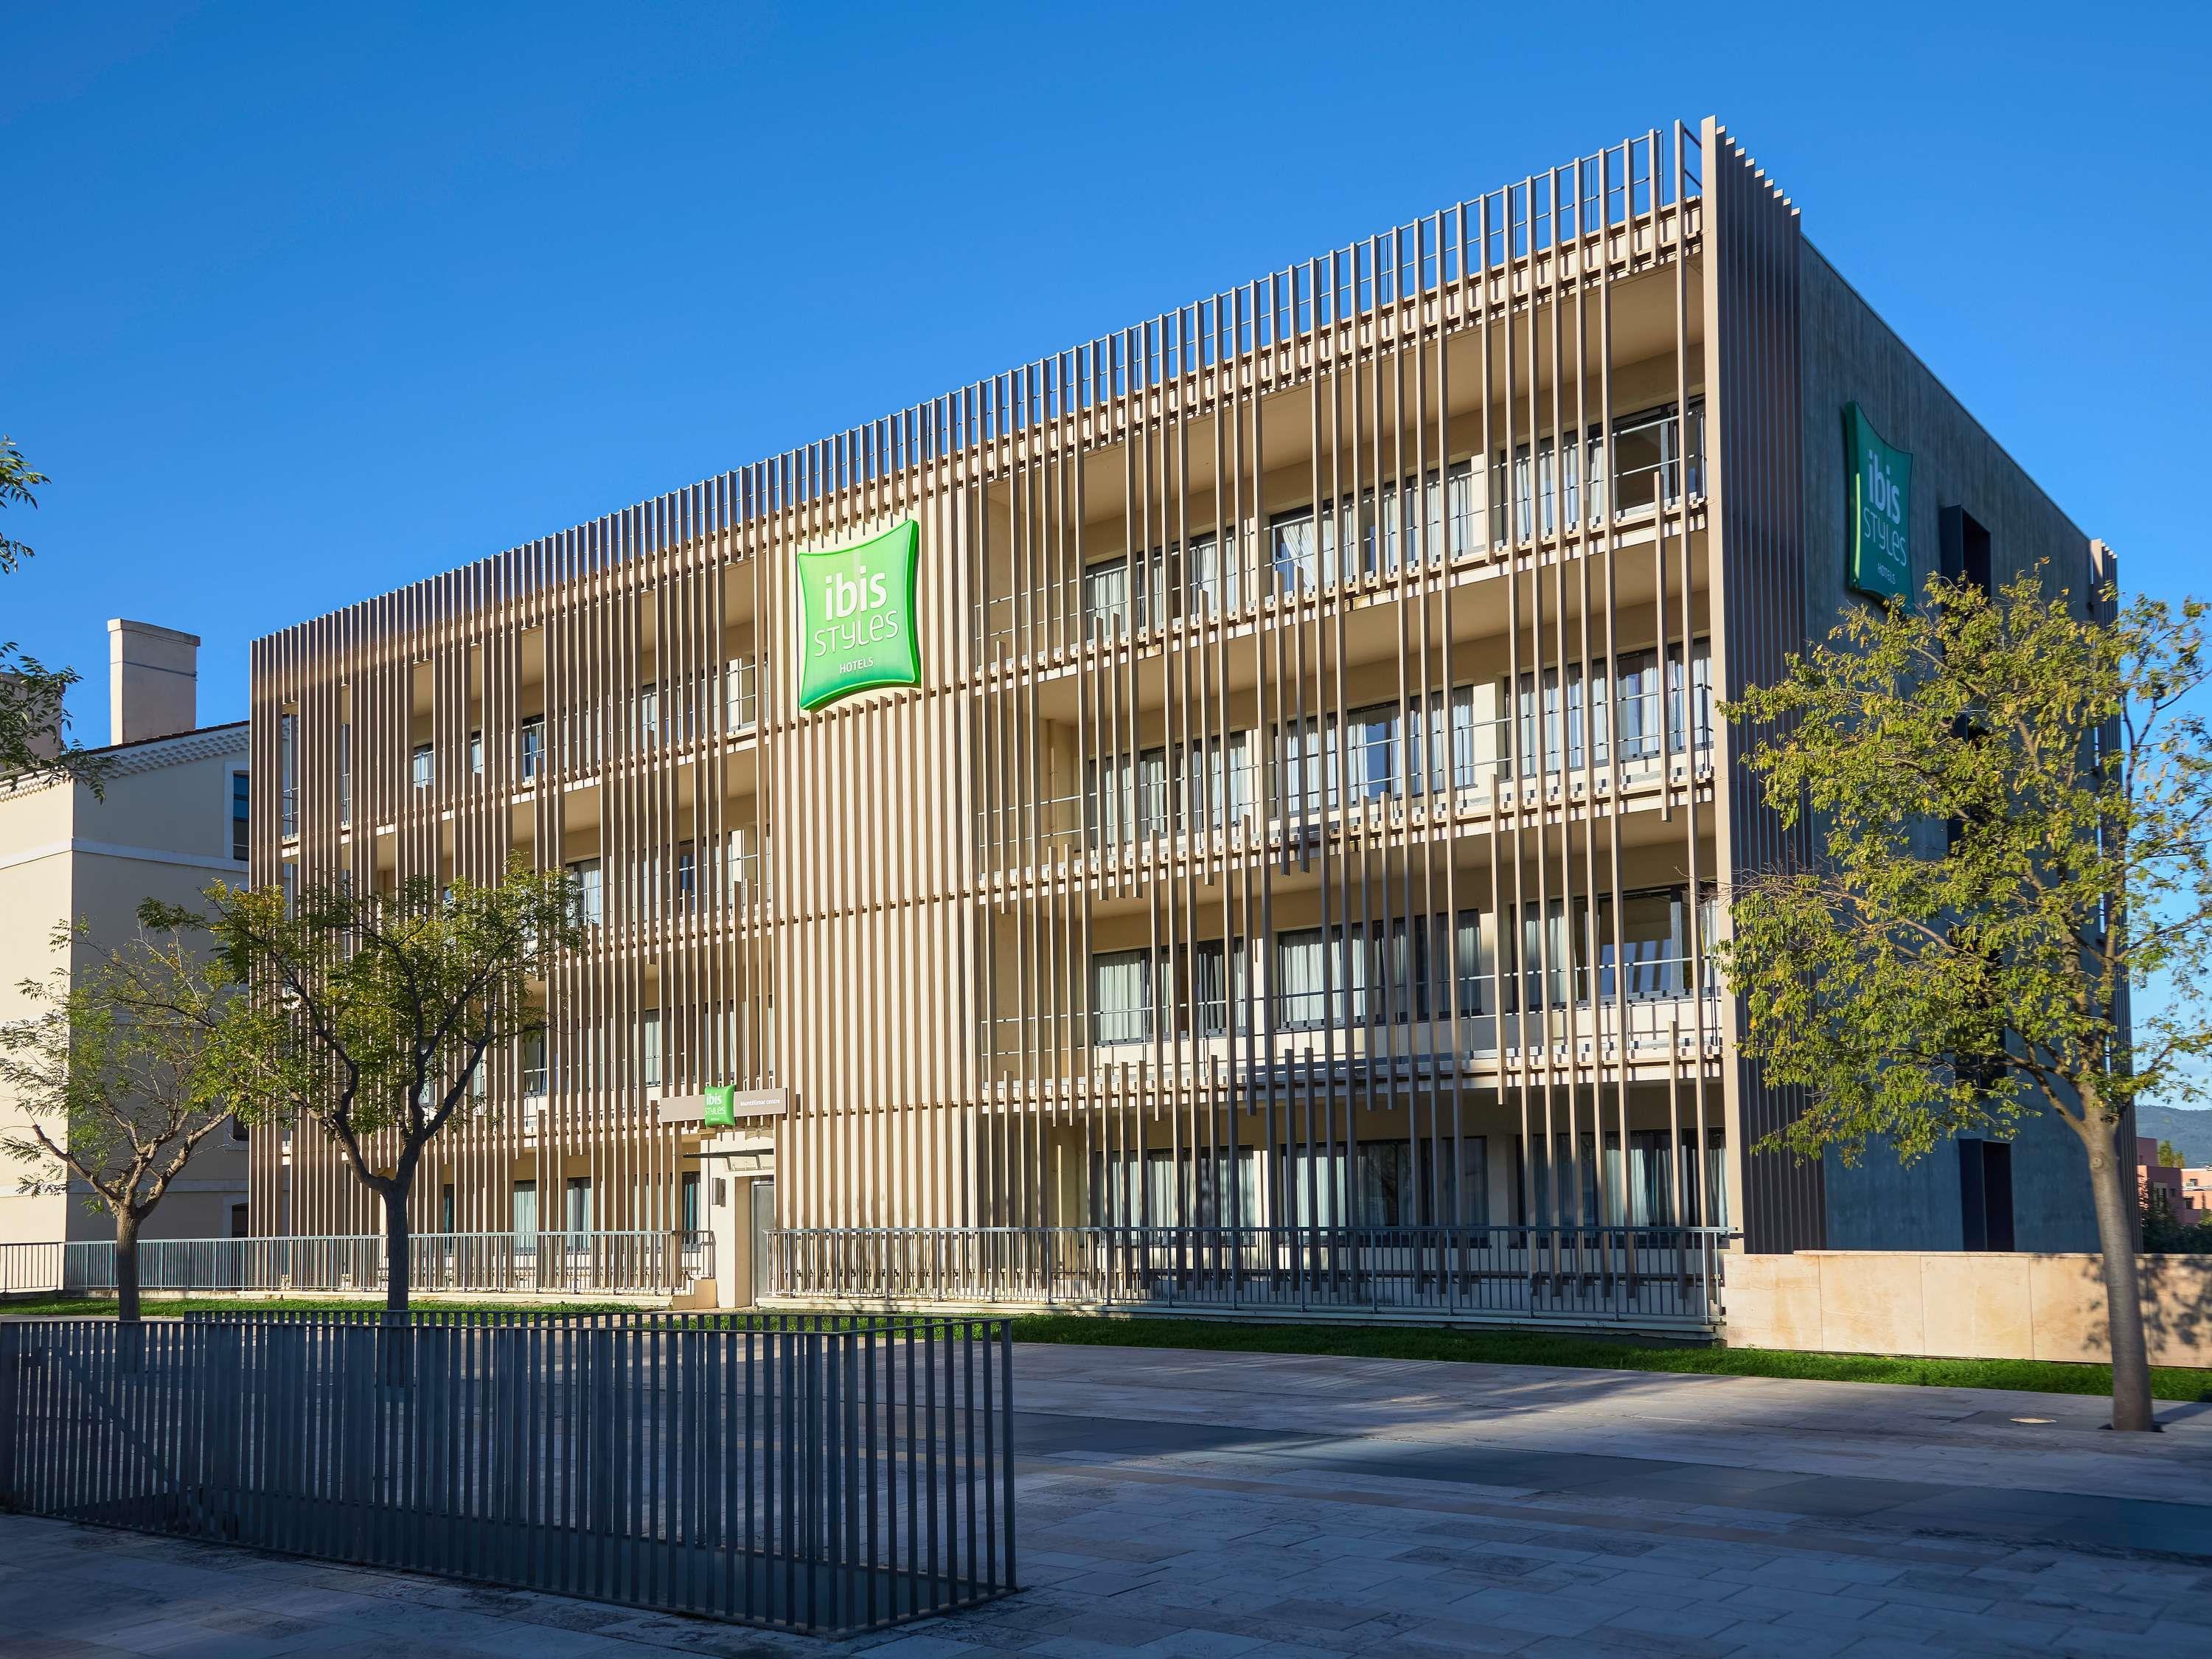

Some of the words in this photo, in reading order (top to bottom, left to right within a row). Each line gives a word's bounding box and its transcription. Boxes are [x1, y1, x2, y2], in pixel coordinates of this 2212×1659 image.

[1868, 448, 1901, 525] ibis
[825, 565, 888, 621] ibis
[839, 656, 874, 674] HOTELS
[706, 1093, 723, 1105] ibis
